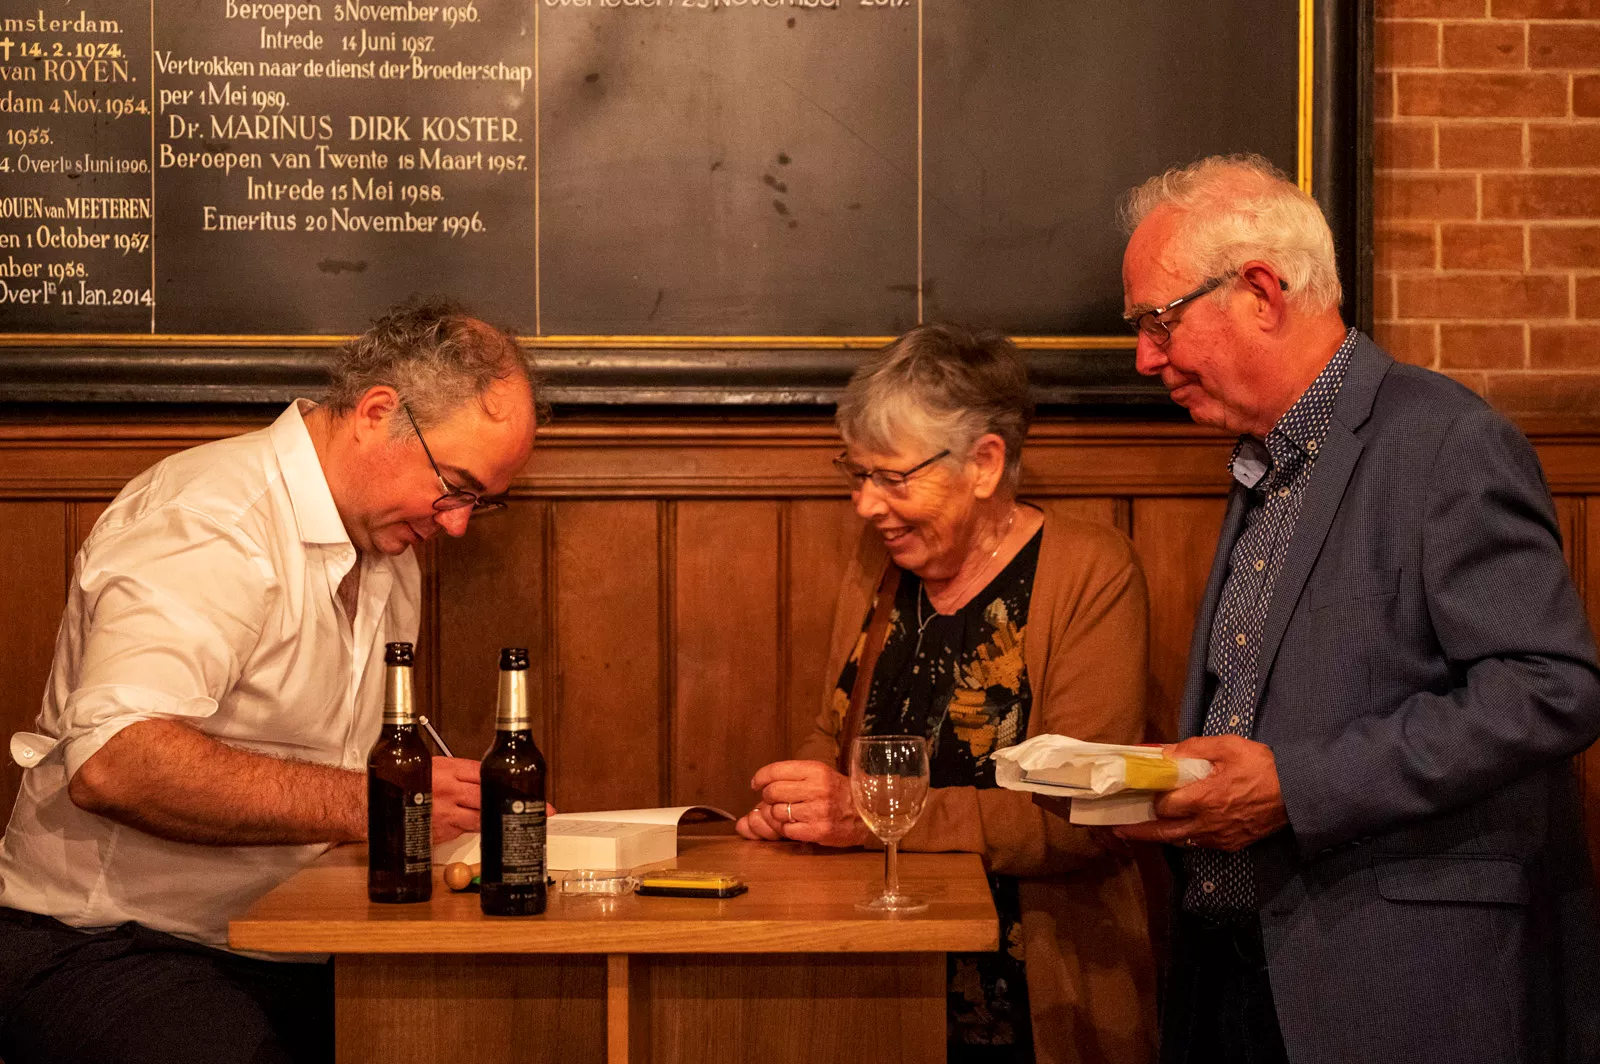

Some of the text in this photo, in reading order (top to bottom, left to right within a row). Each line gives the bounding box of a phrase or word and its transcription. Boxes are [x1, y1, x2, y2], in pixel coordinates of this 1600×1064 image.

[0, 9, 124, 34] msterdam.
[225, 0, 322, 29] Beroepen
[345, 0, 439, 22] November
[442, 1, 481, 29] 1986.
[260, 26, 435, 58] Intrede 14 Juni 1987.
[0, 60, 137, 82] van ROYEN.
[154, 50, 532, 93] Vertrokken naar de dienst der Broederschap
[0, 90, 151, 120] dam 4 Nov. 1954.
[159, 89, 194, 115] per
[207, 81, 247, 106] Mei
[251, 90, 290, 113] 1989.
[7, 126, 54, 151] 1955.
[169, 114, 524, 143] Dr. MARINUS DIRK KOSTER.
[84, 153, 114, 173] Juni
[116, 159, 151, 173] 1996.
[159, 143, 528, 177] Beroepen van Twente 18 Maart 1987.
[247, 176, 445, 206] Intrede 15 Mei 1988.
[45, 206, 65, 219] van
[203, 206, 487, 238] Emeritus 20 November 1996.
[26, 233, 33, 248] 1
[36, 225, 111, 249] October
[48, 260, 89, 284] 1958.
[61, 289, 73, 305] 11
[77, 280, 111, 305] Jan.
[112, 288, 156, 306] 2014.
